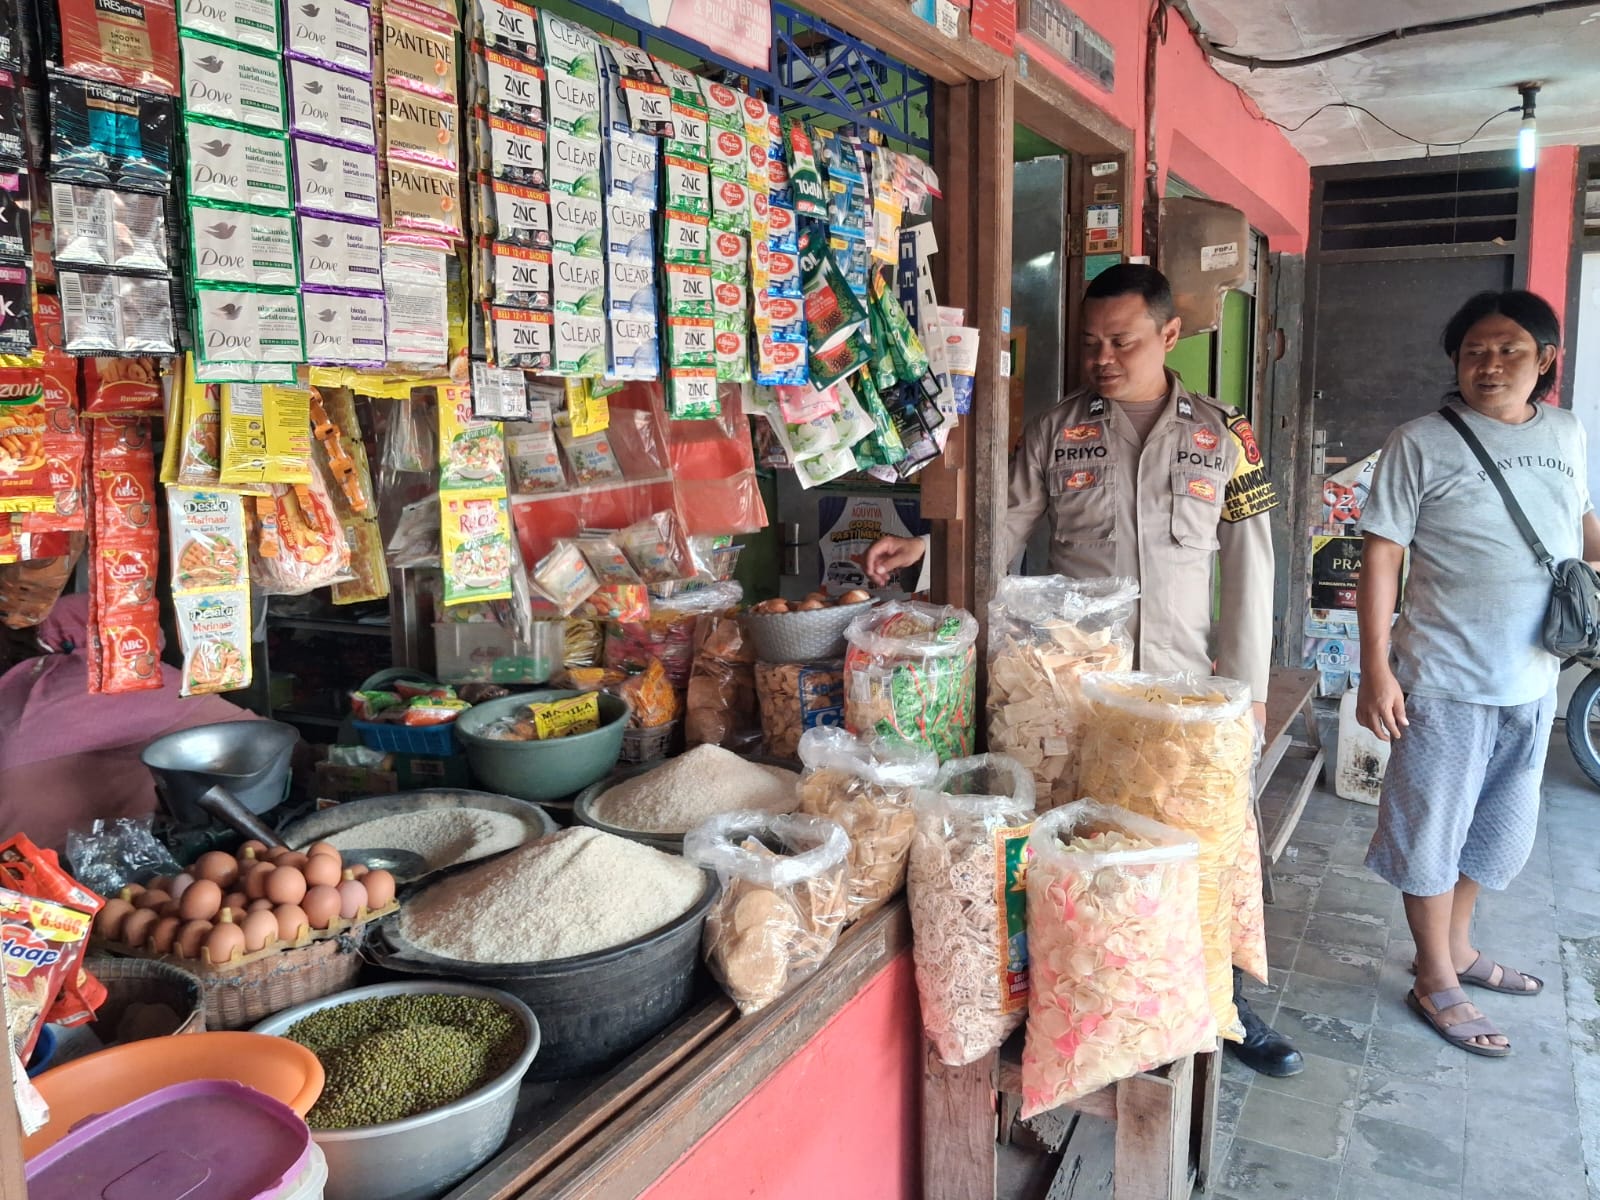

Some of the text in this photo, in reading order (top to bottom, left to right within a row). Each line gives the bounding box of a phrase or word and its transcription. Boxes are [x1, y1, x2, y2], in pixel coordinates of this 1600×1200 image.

[185, 0, 227, 21] Dove
[296, 22, 327, 45] Dove
[549, 18, 590, 50] CLEAR
[385, 25, 452, 64] PANTENE
[189, 79, 233, 105] Dove
[555, 79, 596, 108] CLEAR
[301, 100, 329, 121] Dove
[390, 97, 454, 133] PANTENE
[556, 140, 596, 168] CLEAR
[194, 163, 239, 187] Dove
[391, 169, 456, 199] PANTENE
[306, 177, 334, 197] Dove
[556, 201, 597, 226] CLEAR
[611, 205, 645, 229] CLEAR
[200, 247, 245, 268] Dove
[309, 255, 338, 272] Dove
[559, 261, 600, 285] CLEAR
[615, 263, 649, 283] CLEAR
[39, 303, 57, 315] BC
[207, 329, 252, 347] Dove
[312, 331, 343, 346] Dove
[561, 321, 601, 343] CLEAR
[616, 320, 651, 338] CLEAR
[44, 389, 63, 399] BC
[1054, 445, 1107, 462] PRIYO
[50, 472, 69, 484] BC
[1477, 455, 1574, 482] PAY IT LOUD
[115, 487, 138, 497] ABC
[118, 564, 141, 574] ABC
[121, 638, 144, 650] ABC
[1316, 653, 1351, 664] TOP
